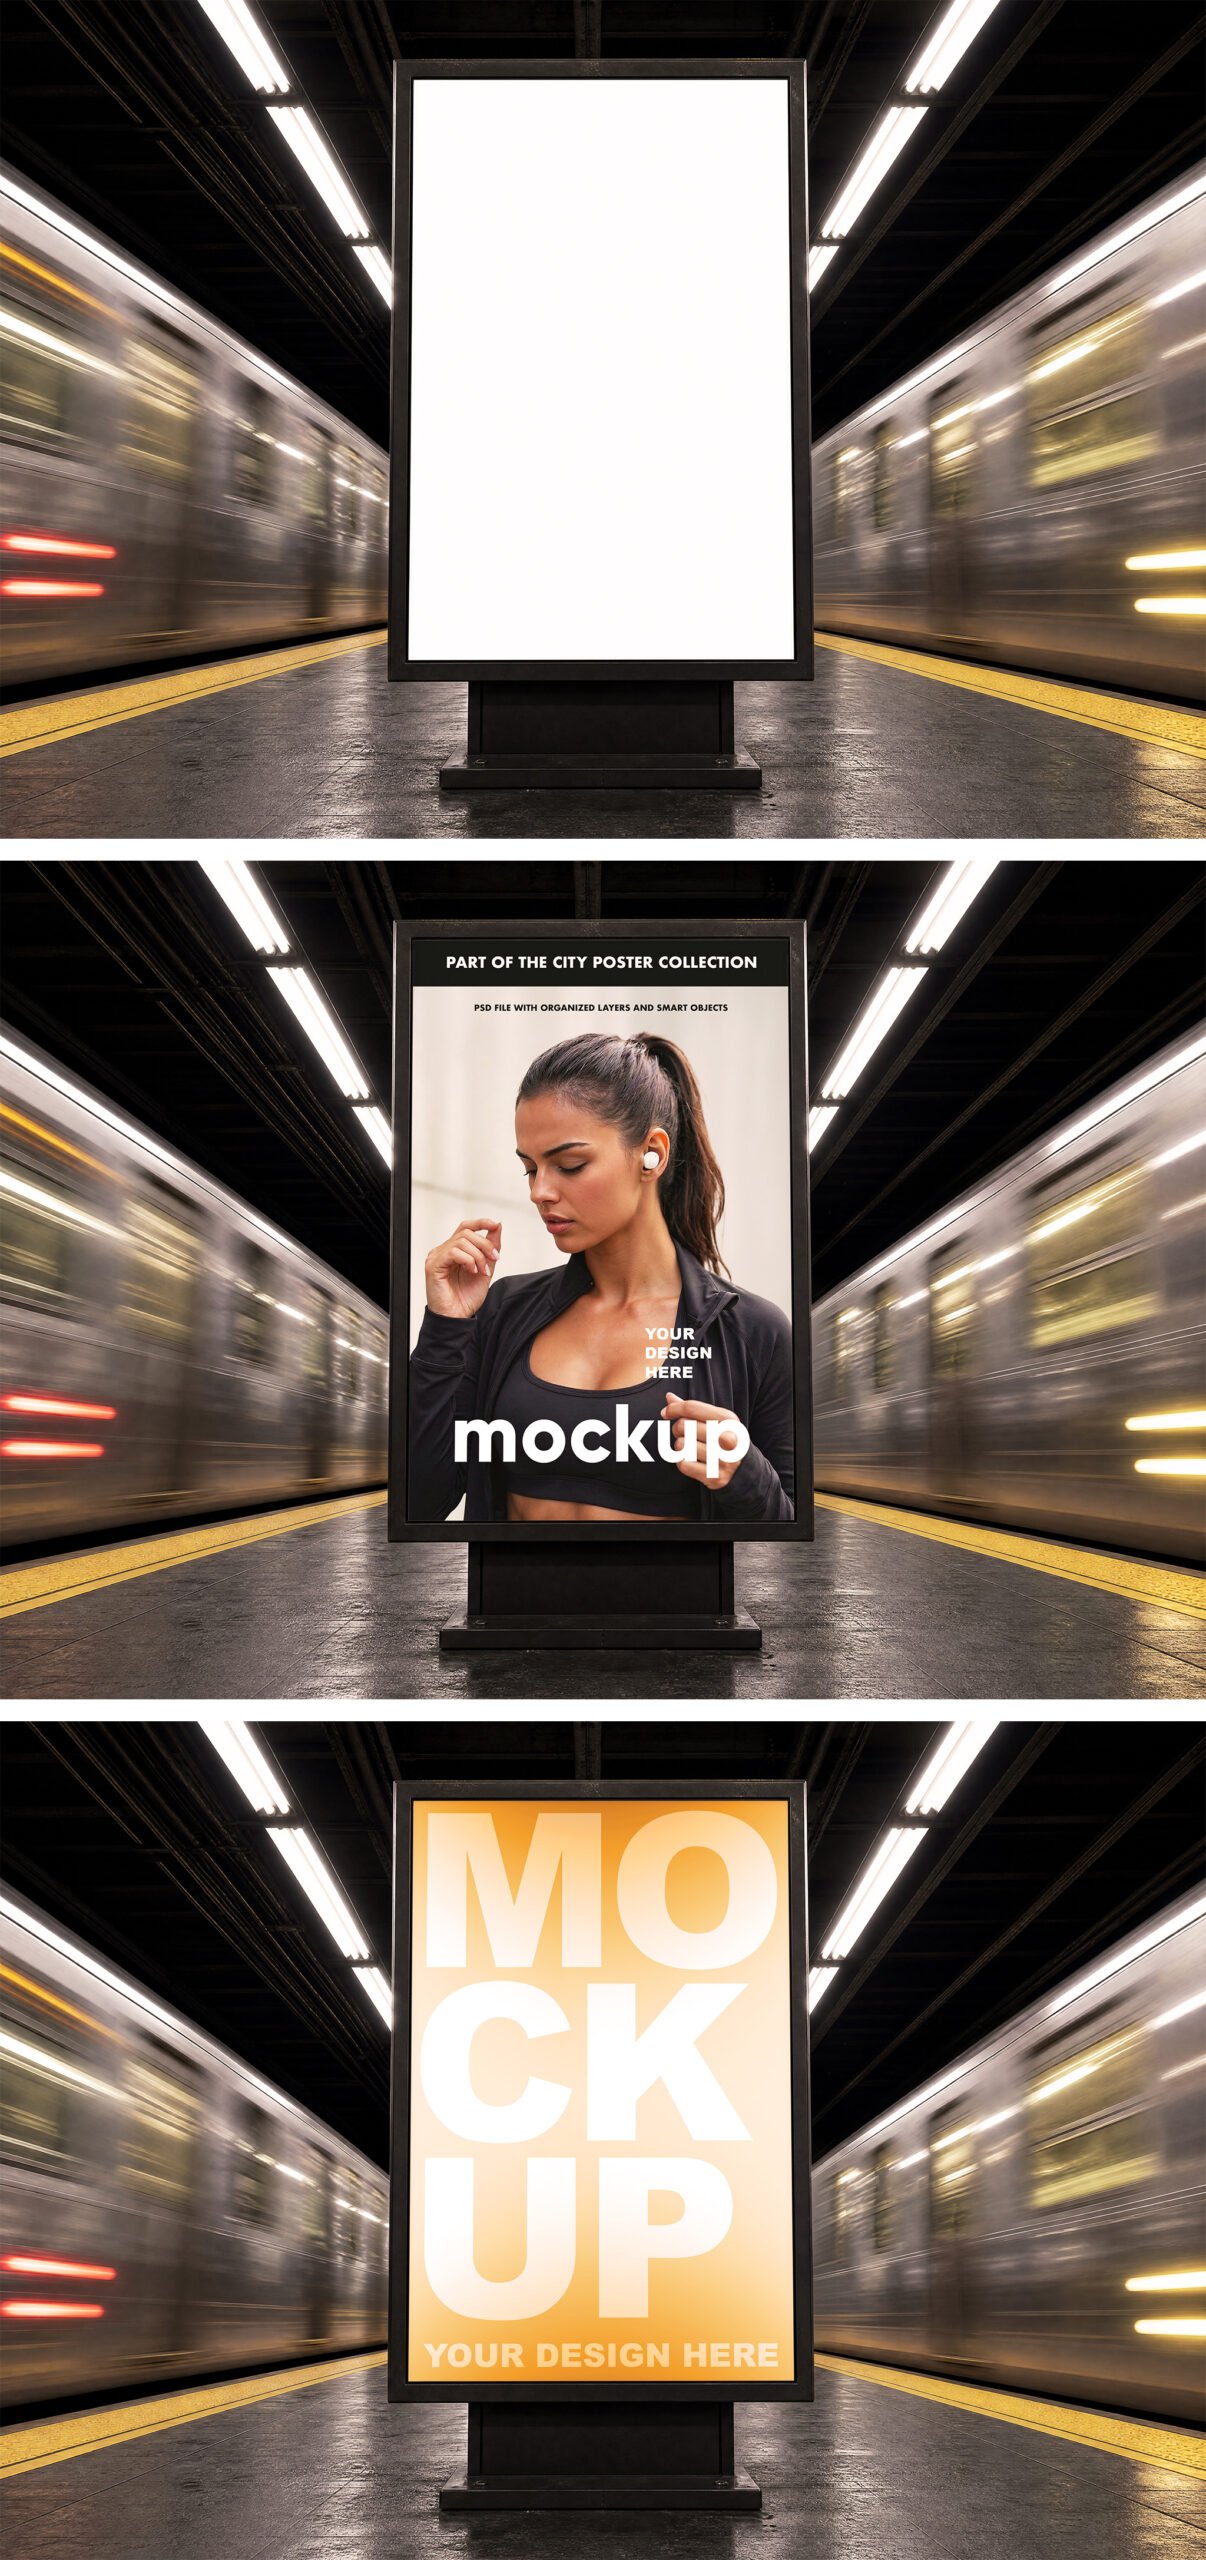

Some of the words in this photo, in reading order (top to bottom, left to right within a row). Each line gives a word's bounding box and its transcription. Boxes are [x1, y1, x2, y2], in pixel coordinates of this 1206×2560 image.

[446, 956, 487, 969] PART
[491, 956, 514, 969] OF
[518, 956, 547, 969] THE
[552, 956, 587, 969] CITY
[593, 956, 653, 969] POSTER
[658, 956, 757, 969] COLLECTION
[474, 1004, 491, 1012] PSD
[494, 1004, 511, 1012] FILE
[514, 1004, 538, 1012] WITH
[540, 1004, 595, 1012] ORGANIZED
[597, 1004, 631, 1012] LAYERS
[633, 1004, 654, 1012] AND
[656, 1004, 688, 1012] SMART
[690, 1004, 728, 1012] OBJECTS
[644, 1327, 695, 1341] YOUR
[645, 1346, 712, 1360] DESIGN
[645, 1366, 693, 1379] HERE
[454, 1403, 750, 1479] mockup
[426, 1811, 778, 1970] MO
[420, 1981, 752, 2143] CK
[424, 2157, 734, 2321] UP
[424, 2343, 525, 2368] YOUR
[536, 2343, 670, 2368] DESIGN
[684, 2343, 779, 2368] HERE
